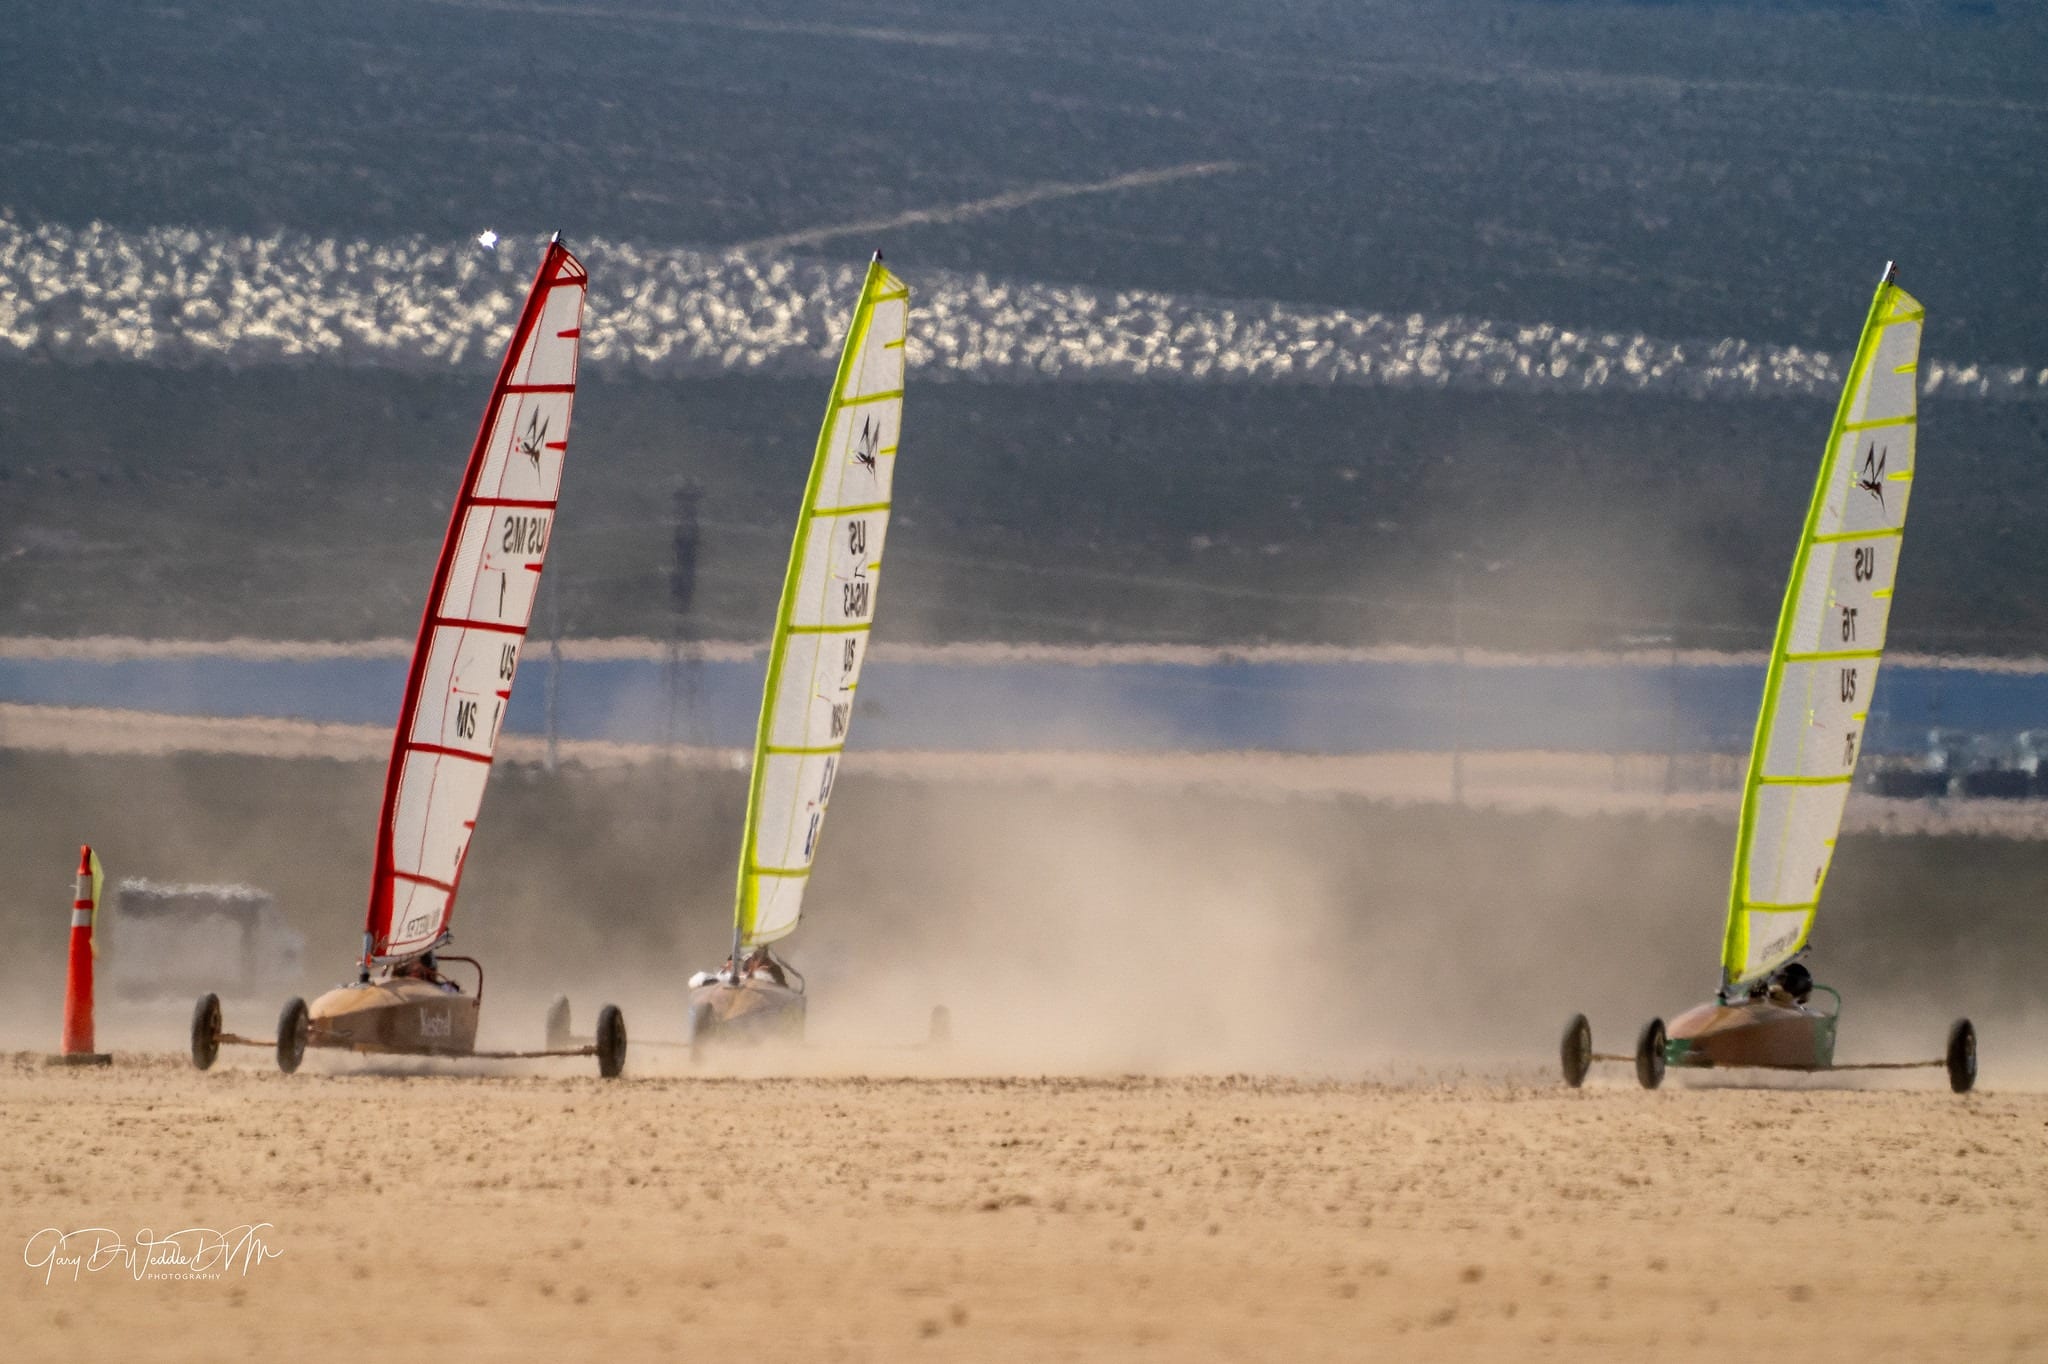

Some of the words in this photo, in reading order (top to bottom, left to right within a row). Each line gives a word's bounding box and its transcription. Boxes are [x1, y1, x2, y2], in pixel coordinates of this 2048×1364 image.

[500, 643, 516, 681] US
[1841, 667, 1857, 703] US
[456, 700, 477, 739] MS
